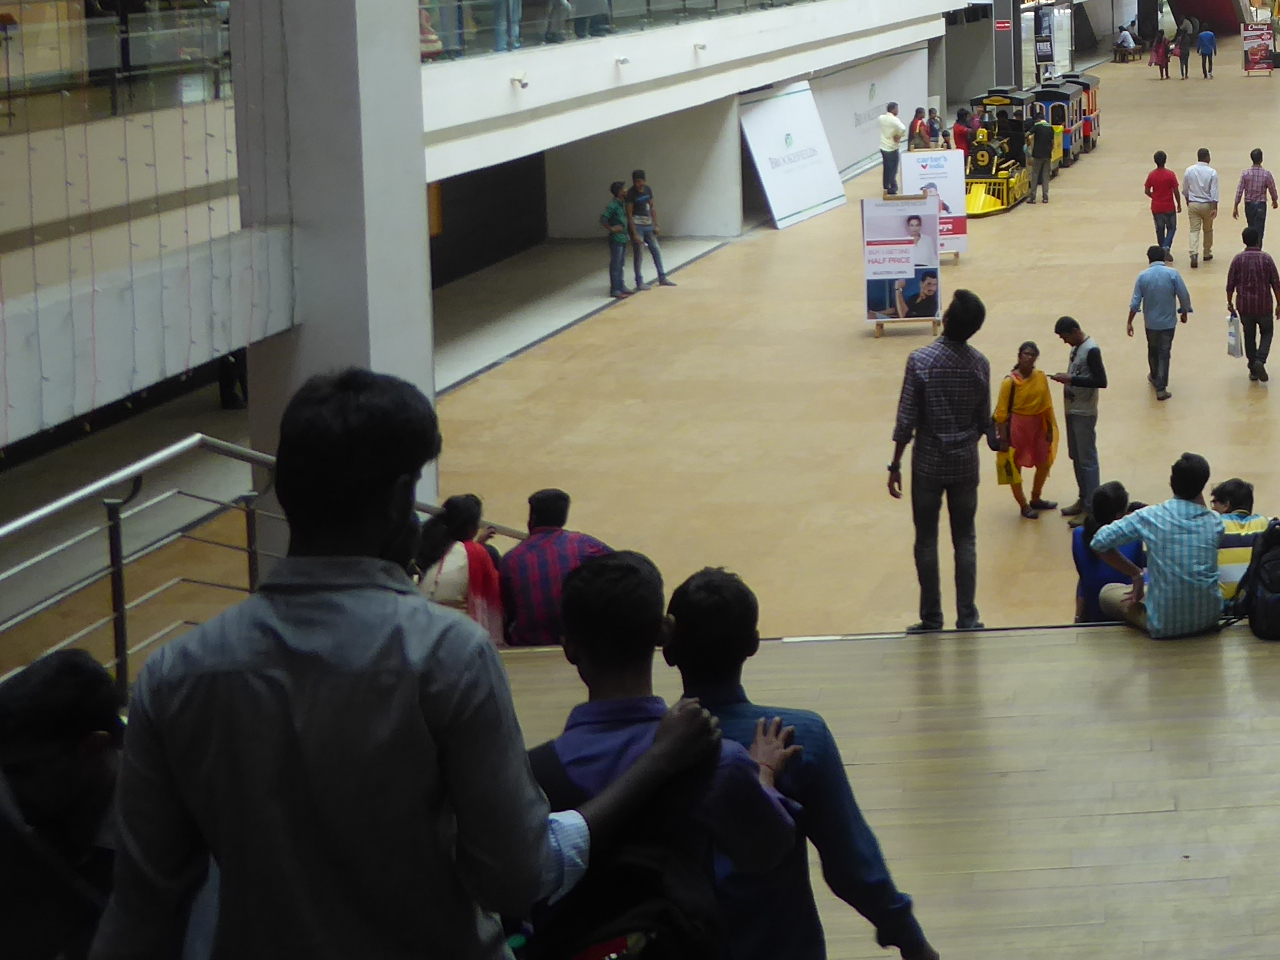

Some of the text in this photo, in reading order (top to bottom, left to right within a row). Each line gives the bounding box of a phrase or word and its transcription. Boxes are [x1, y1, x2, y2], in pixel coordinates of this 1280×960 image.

[916, 155, 948, 164] carter's
[976, 150, 990, 166] 9
[867, 256, 911, 265] HALF PRICE
